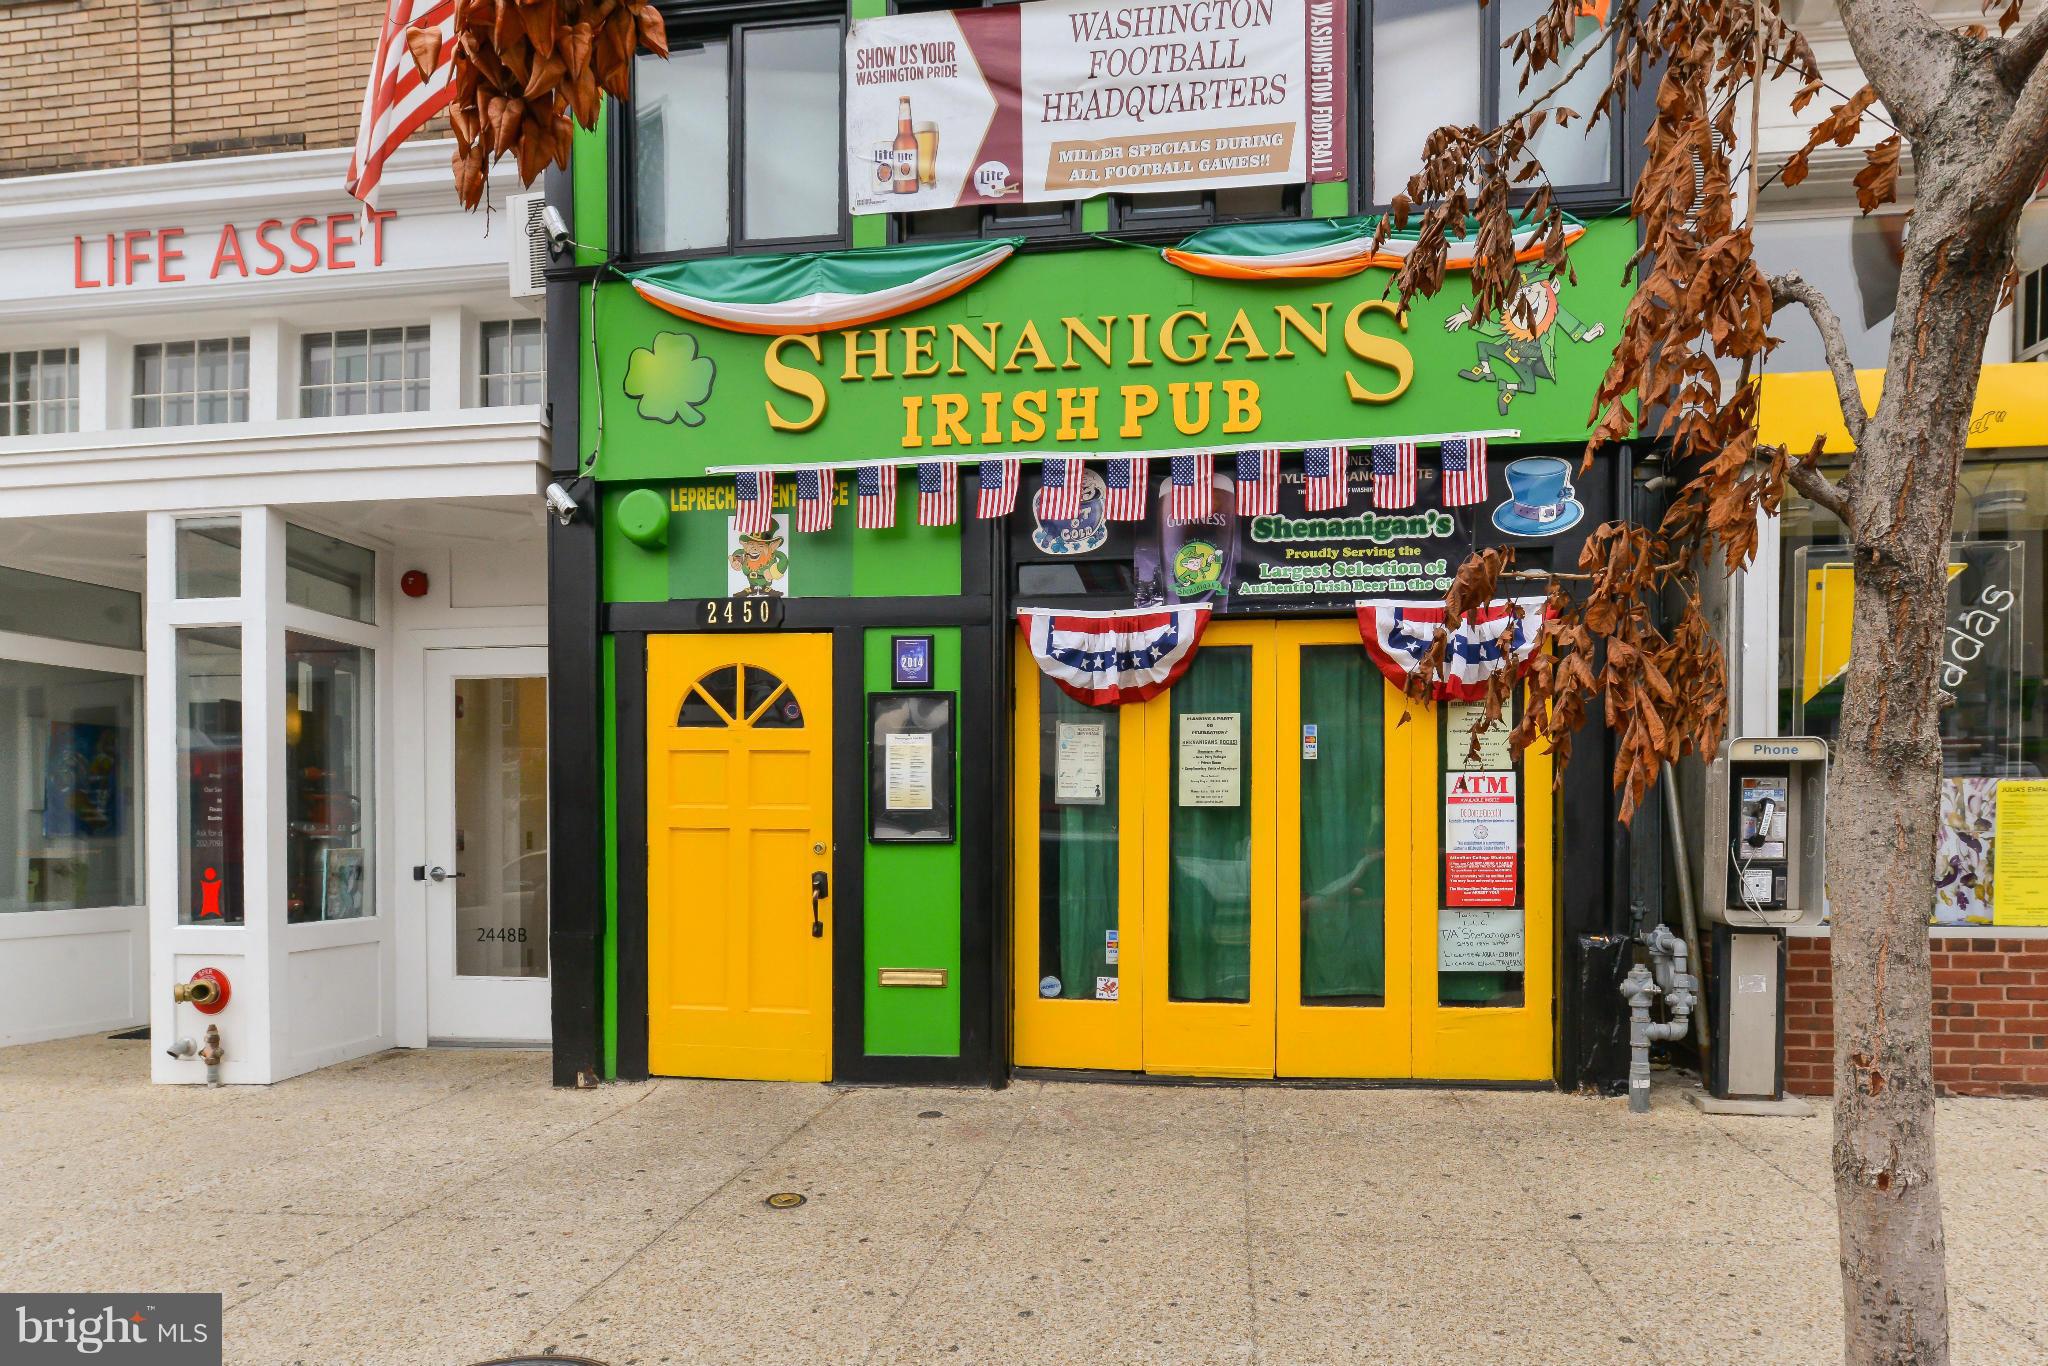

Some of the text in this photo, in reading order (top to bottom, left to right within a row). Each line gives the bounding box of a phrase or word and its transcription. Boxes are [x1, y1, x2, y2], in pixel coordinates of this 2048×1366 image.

[1069, 0, 1273, 42] WASHINGTON
[856, 41, 956, 70] SHOW US YOUR
[1088, 38, 1247, 79] FOOTBALL
[856, 64, 958, 86] WASHINGTON PRIDE
[1041, 74, 1288, 123] HEADQUARTERS
[1310, 1, 1333, 175] WASHINGTON FOOTBALL
[874, 149, 894, 163] Lite
[897, 152, 913, 163] Lite
[1058, 132, 1285, 163] MILLER SPECIALS DURING
[980, 170, 1004, 185] Lite
[1068, 154, 1272, 183] ALL FOOTBALL GAMES!!
[74, 209, 398, 289] LIFE ASSET
[763, 299, 1415, 432] SHENANIGANS
[901, 378, 1263, 447] IRISH PUB
[1280, 473, 1307, 484] TYLE
[671, 481, 849, 511] LEPRECH ENTCE
[1251, 509, 1455, 544] Shenanigan's
[1285, 545, 1422, 560] Proudly Serving the
[1259, 558, 1447, 580] Largest Selection of
[1238, 577, 1456, 596] Authentic Irish Beer in the Ci
[707, 601, 770, 624] 2450
[901, 657, 924, 668] 2014
[1754, 744, 1799, 755] Phone
[1452, 776, 1509, 795] ATM
[477, 927, 528, 943] 2448B
